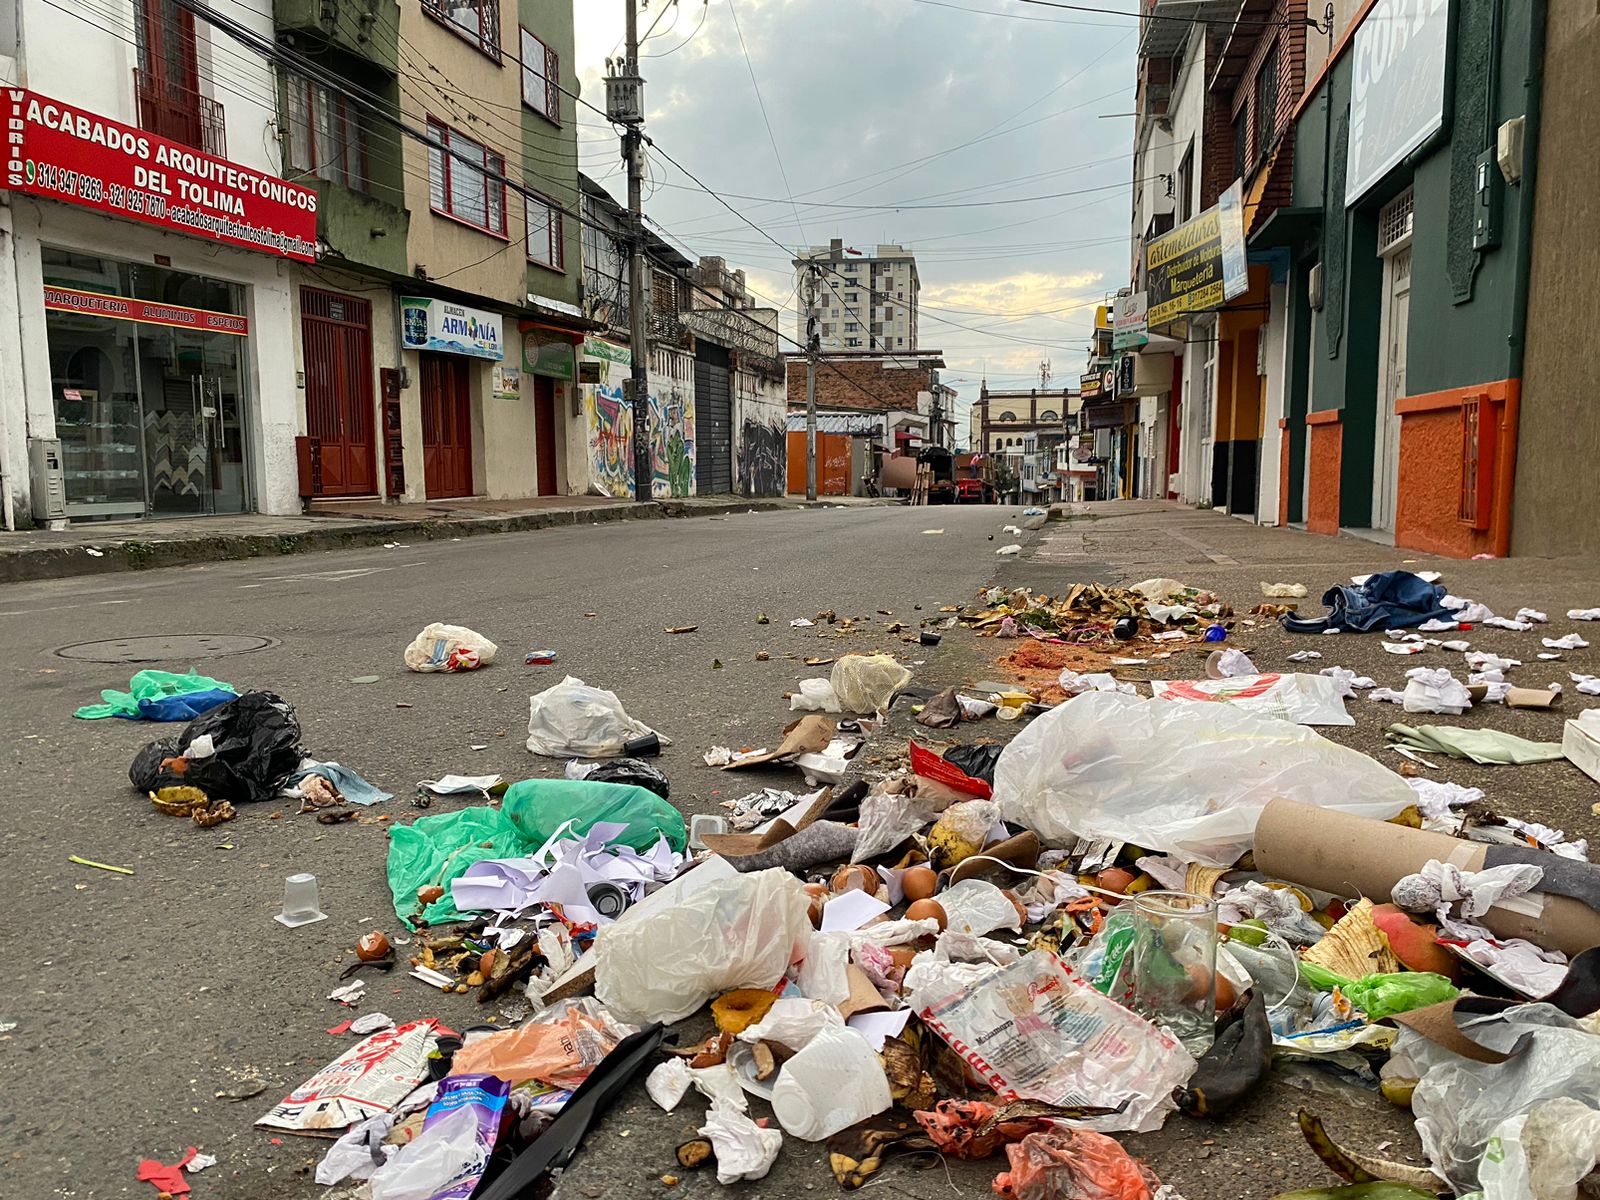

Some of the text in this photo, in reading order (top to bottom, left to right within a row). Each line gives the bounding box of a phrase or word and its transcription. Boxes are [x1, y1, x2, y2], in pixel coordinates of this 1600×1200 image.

[8, 90, 24, 185] VIDRIOS
[26, 99, 317, 213] ACABADOS ARQUITECTÓNICOS
[38, 162, 57, 190] 314
[59, 168, 78, 195] 347
[79, 174, 103, 202] 9263
[109, 183, 126, 208] 321
[127, 188, 143, 213] 925
[145, 193, 166, 219] 7870
[134, 165, 246, 217] DEL TOLIMA
[44, 289, 129, 314] MARQUETERIA
[142, 305, 196, 324] ALUMINIOS
[443, 305, 465, 317] ALMACEN
